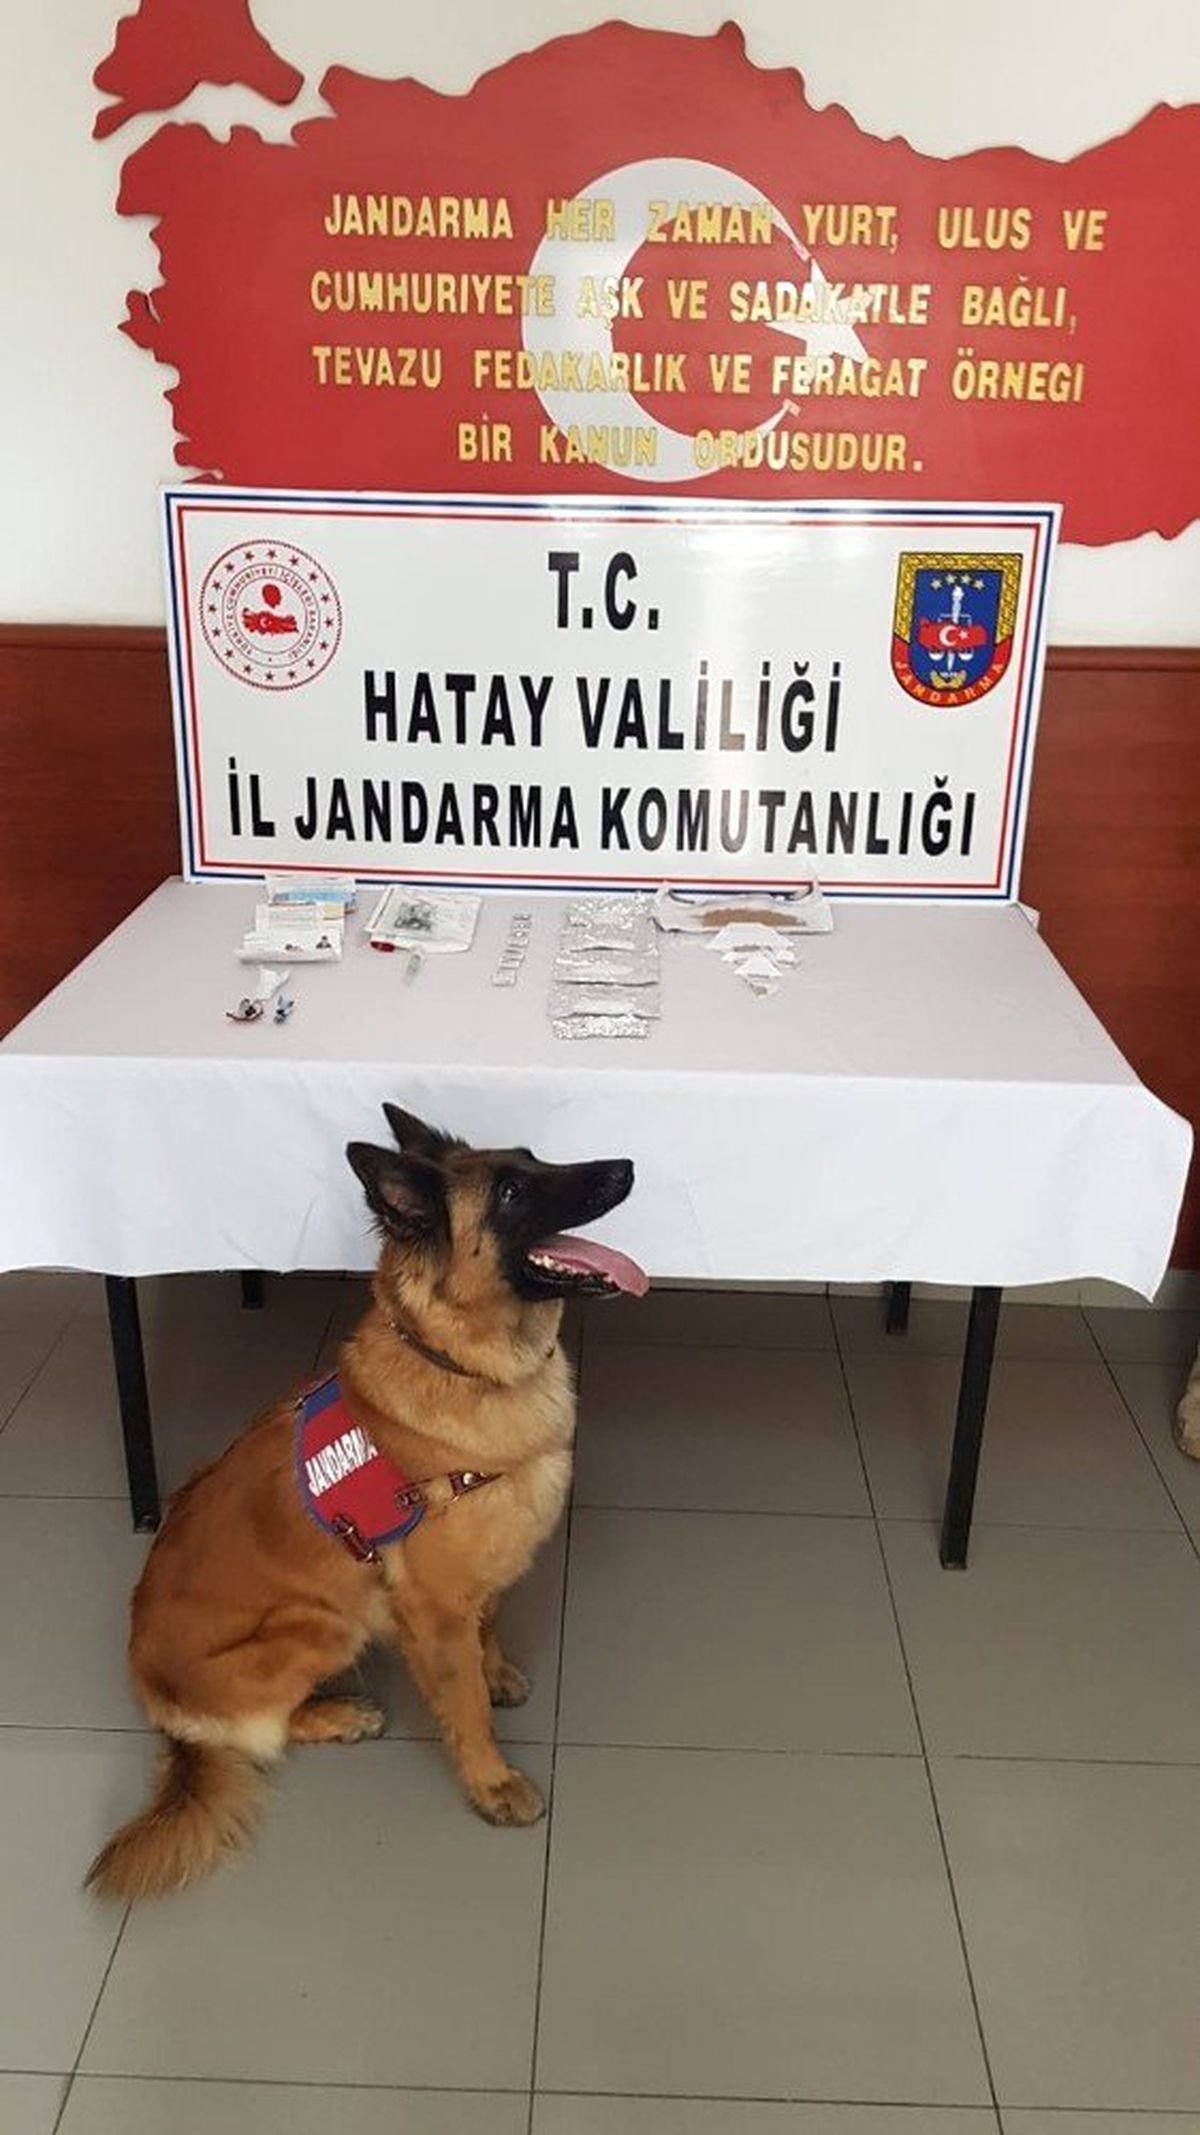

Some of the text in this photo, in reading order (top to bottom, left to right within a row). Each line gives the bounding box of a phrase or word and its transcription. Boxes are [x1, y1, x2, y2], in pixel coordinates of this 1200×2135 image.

[324, 194, 1108, 254] JANDARMA HER ZAMAN YURT, ULUS VE
[310, 270, 557, 317] CUMHURIYETE
[577, 276, 645, 332] AŞK
[667, 280, 708, 320] VE
[729, 281, 932, 325] SADAKATLE
[312, 346, 442, 388] TEVAZU
[474, 350, 687, 393] FEDAKARLIK
[709, 354, 753, 394] VE
[771, 356, 928, 398] FERAGAT
[457, 413, 513, 463] BİR
[540, 424, 658, 467] KANUN
[548, 551, 660, 631] T.C.
[364, 660, 842, 753] HATAY VALİLİĞİ
[895, 661, 1003, 704] JANDARMA
[228, 756, 976, 857] İL JANDARMA KOMUTANLIĞI
